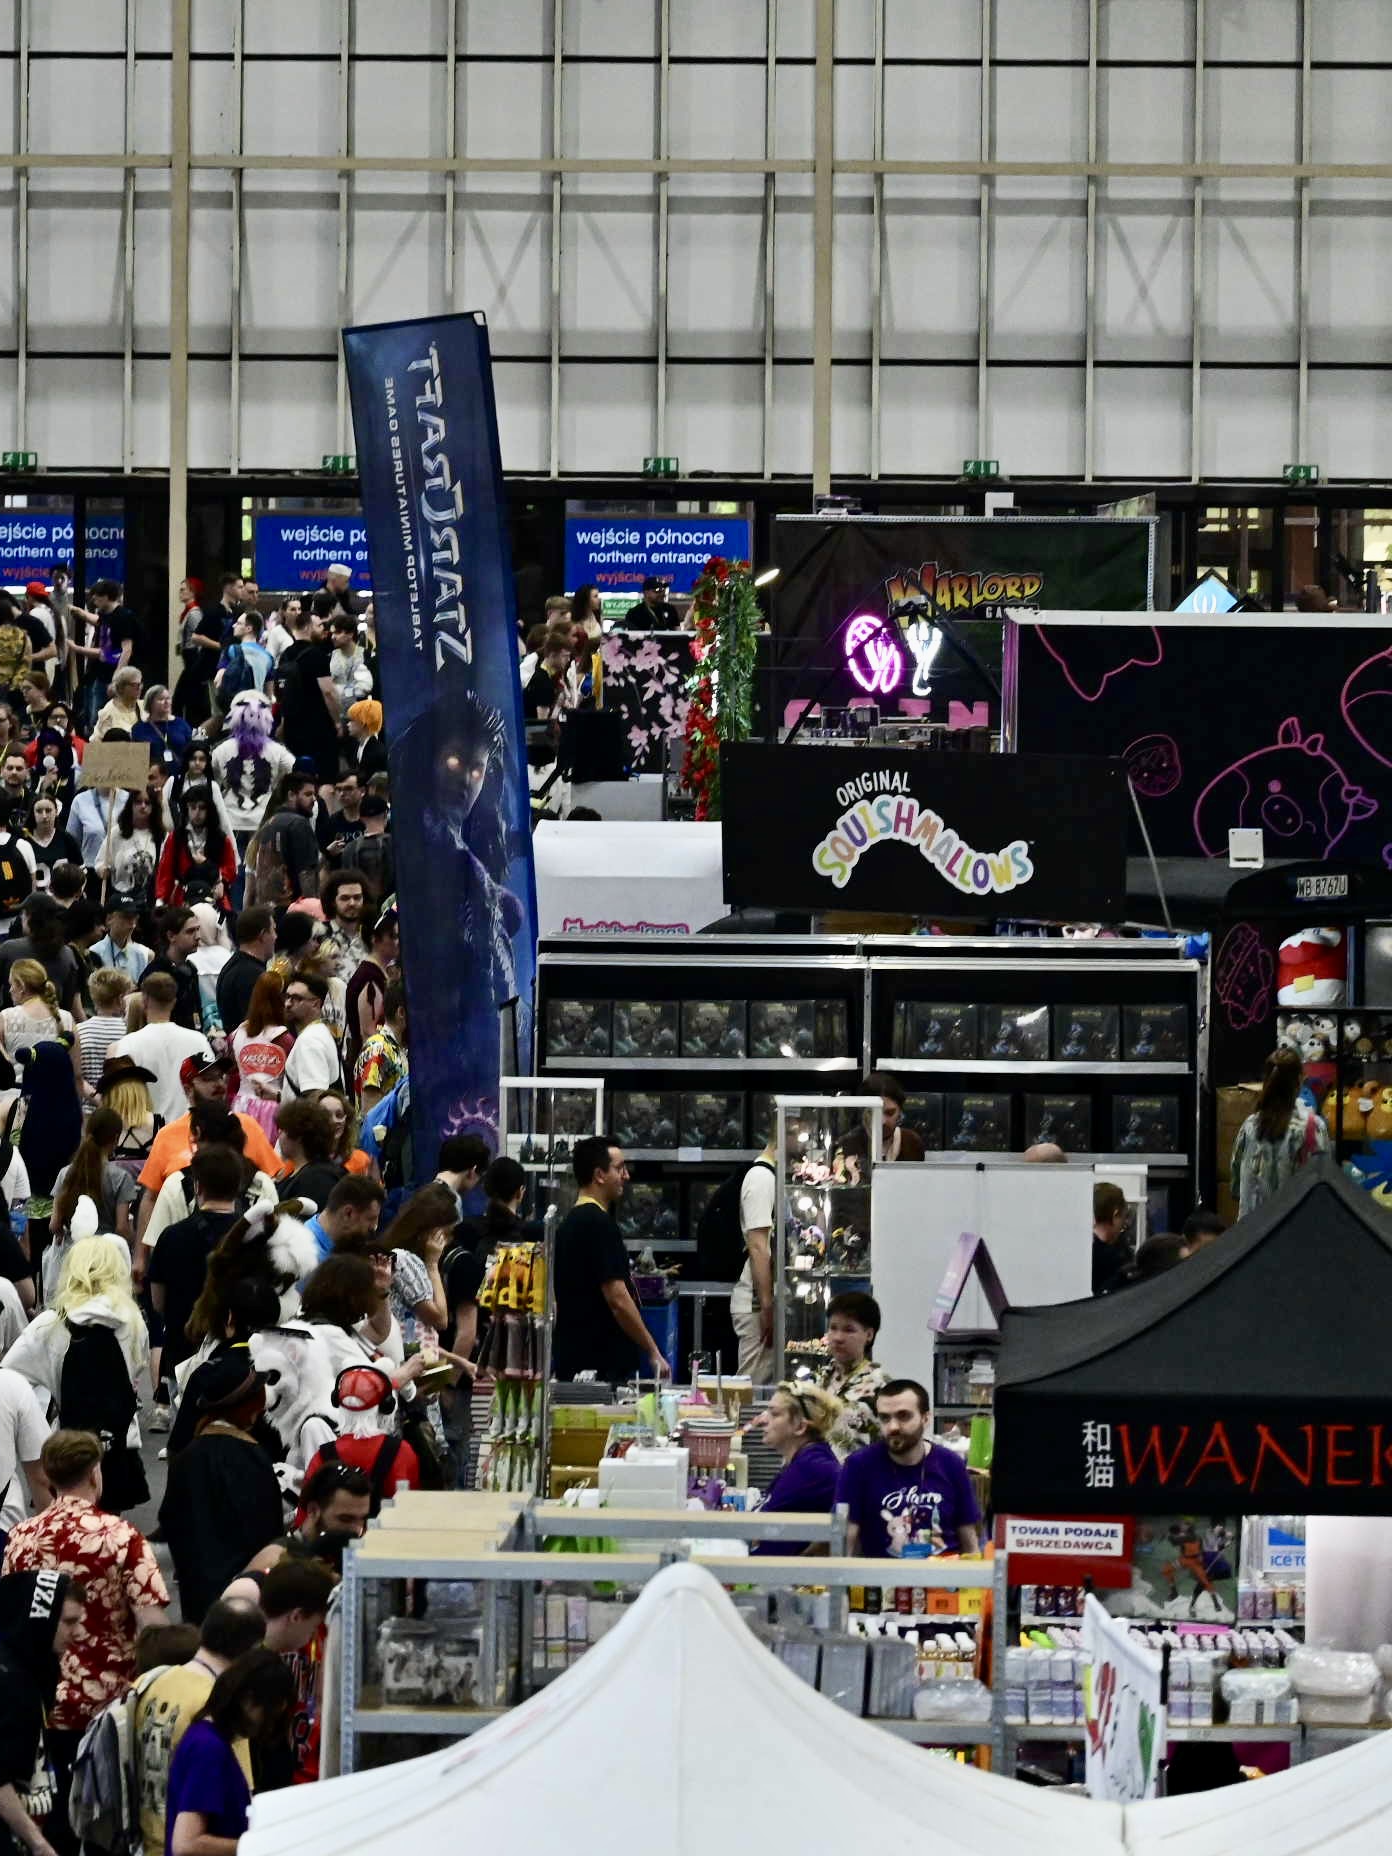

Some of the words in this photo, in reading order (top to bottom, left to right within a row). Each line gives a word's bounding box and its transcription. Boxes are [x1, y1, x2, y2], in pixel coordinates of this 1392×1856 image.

[280, 526, 344, 545] wejście
[576, 528, 640, 548] wejście
[645, 528, 725, 548] północne
[57, 548, 119, 559] enance
[293, 549, 351, 561] northern
[589, 550, 647, 563] northern
[651, 550, 711, 564] entrance
[836, 768, 912, 807] ORIGINAL
[814, 796, 1033, 893] SQUISHMALLOWS
[1082, 1420, 1116, 1488] 和猫
[1010, 1525, 1060, 1536] TOWAR
[1064, 1527, 1119, 1538] PODAJE
[1016, 1539, 1113, 1550] SPRZEDAWCA
